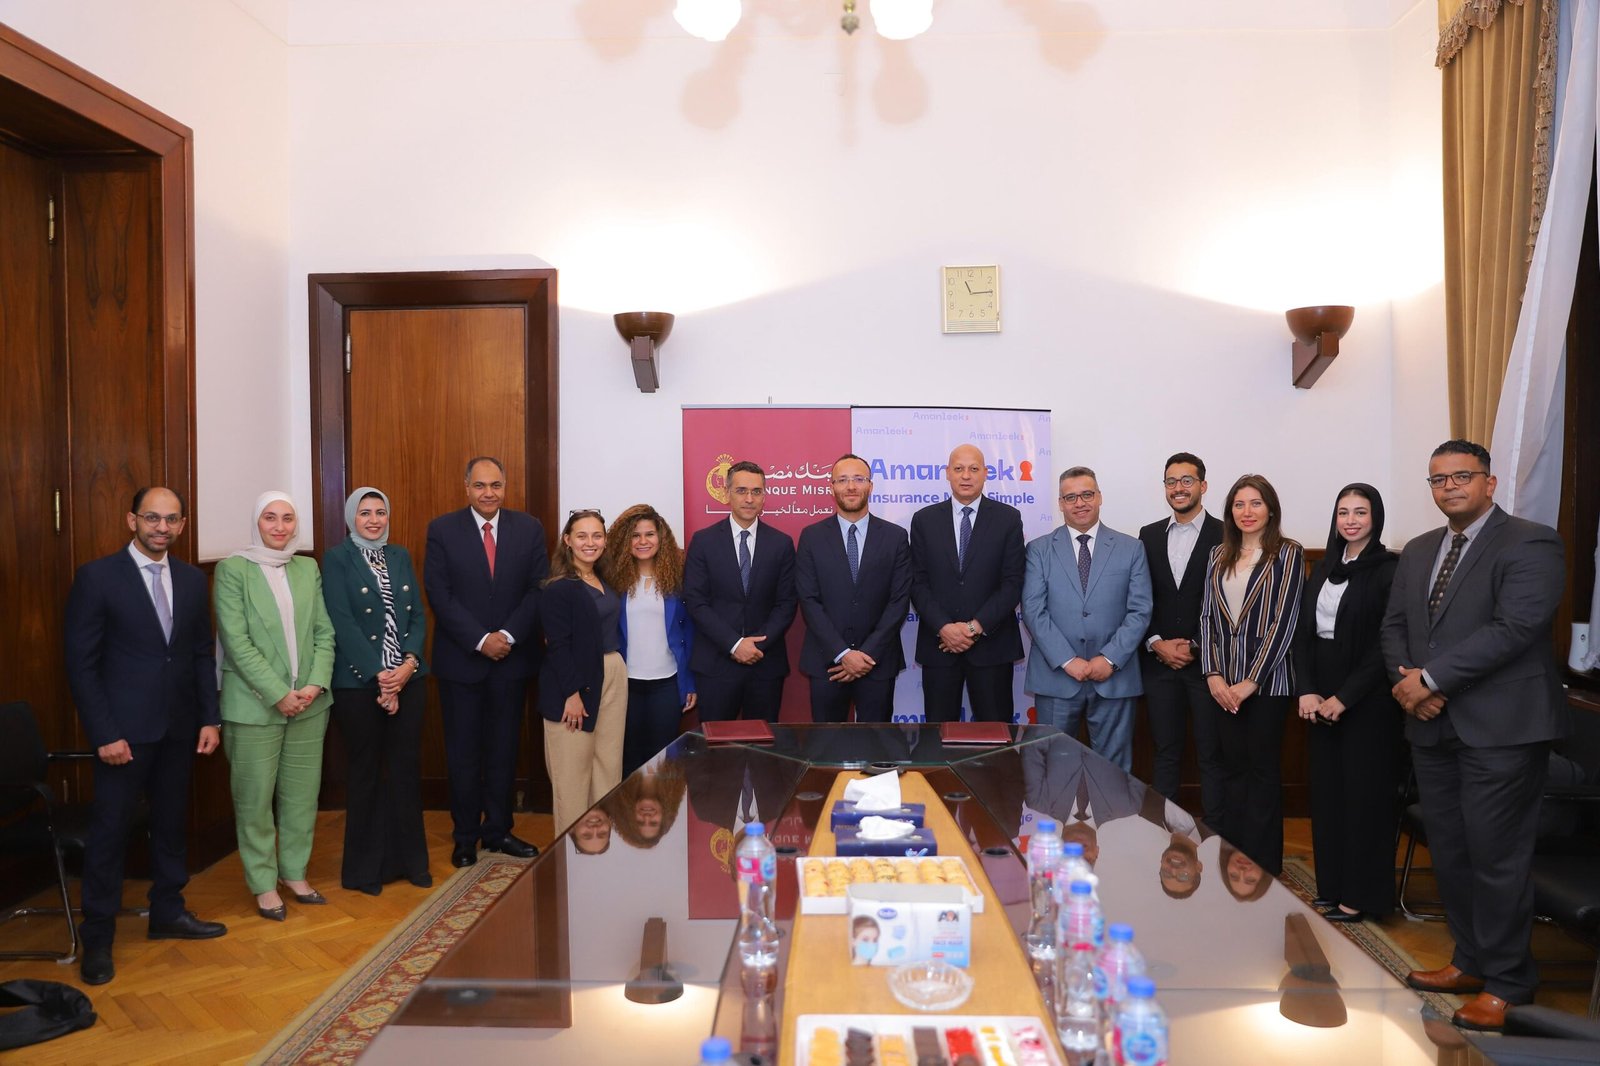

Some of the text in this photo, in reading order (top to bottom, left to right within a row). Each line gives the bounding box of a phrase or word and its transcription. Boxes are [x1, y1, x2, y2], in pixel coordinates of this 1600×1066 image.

[764, 464, 794, 480] مص
[870, 458, 1015, 481] Amanek
[763, 486, 797, 495] NQUE
[987, 492, 1035, 507] Simple
